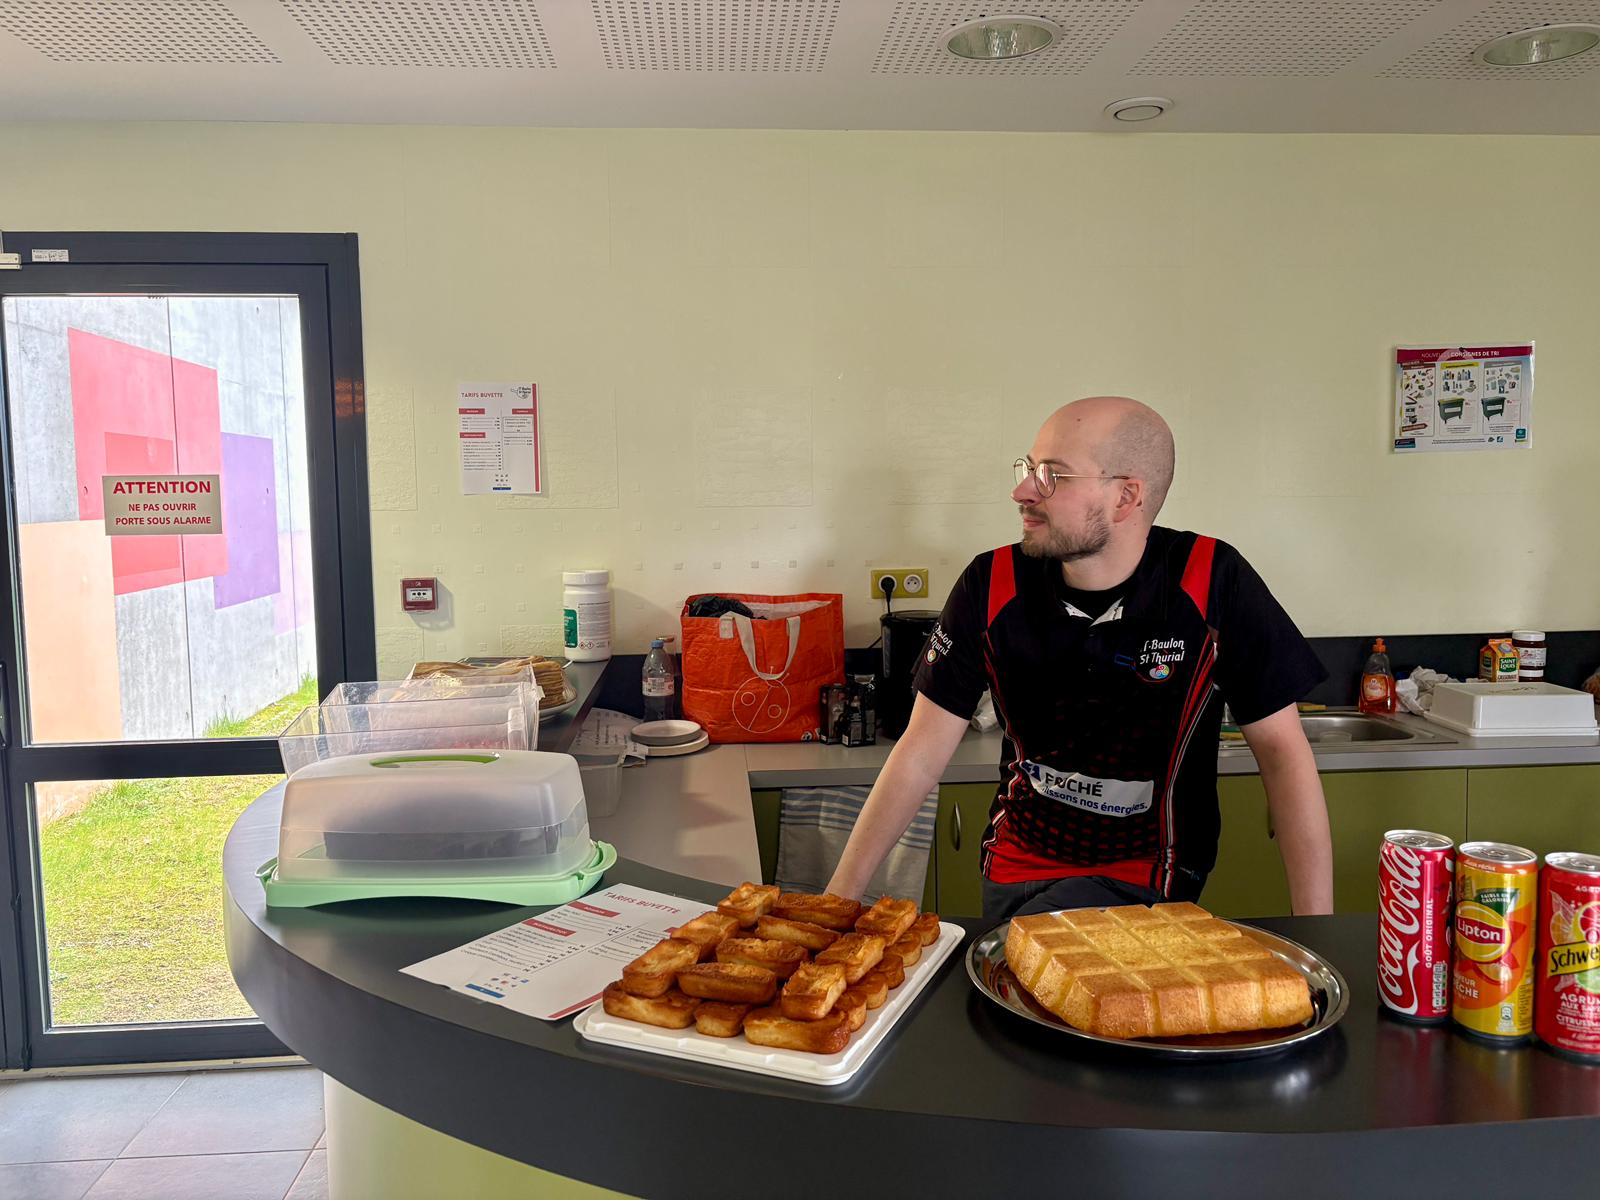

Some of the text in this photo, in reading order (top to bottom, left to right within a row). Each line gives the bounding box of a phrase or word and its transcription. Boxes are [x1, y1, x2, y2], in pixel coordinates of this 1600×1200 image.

[113, 480, 211, 494] ATTENTION
[128, 503, 197, 512] NE PAS OUVRIR
[115, 516, 211, 525] PORTE SOUS ALARME
[1139, 650, 1185, 665] St Thurial
[1080, 799, 1099, 810] nos
[603, 891, 682, 914] TARIFS BUVETTE
[1424, 898, 1434, 968] GOÛT ORIGINAL
[1457, 919, 1501, 941] Lipton
[1551, 946, 1600, 973] Schwe
